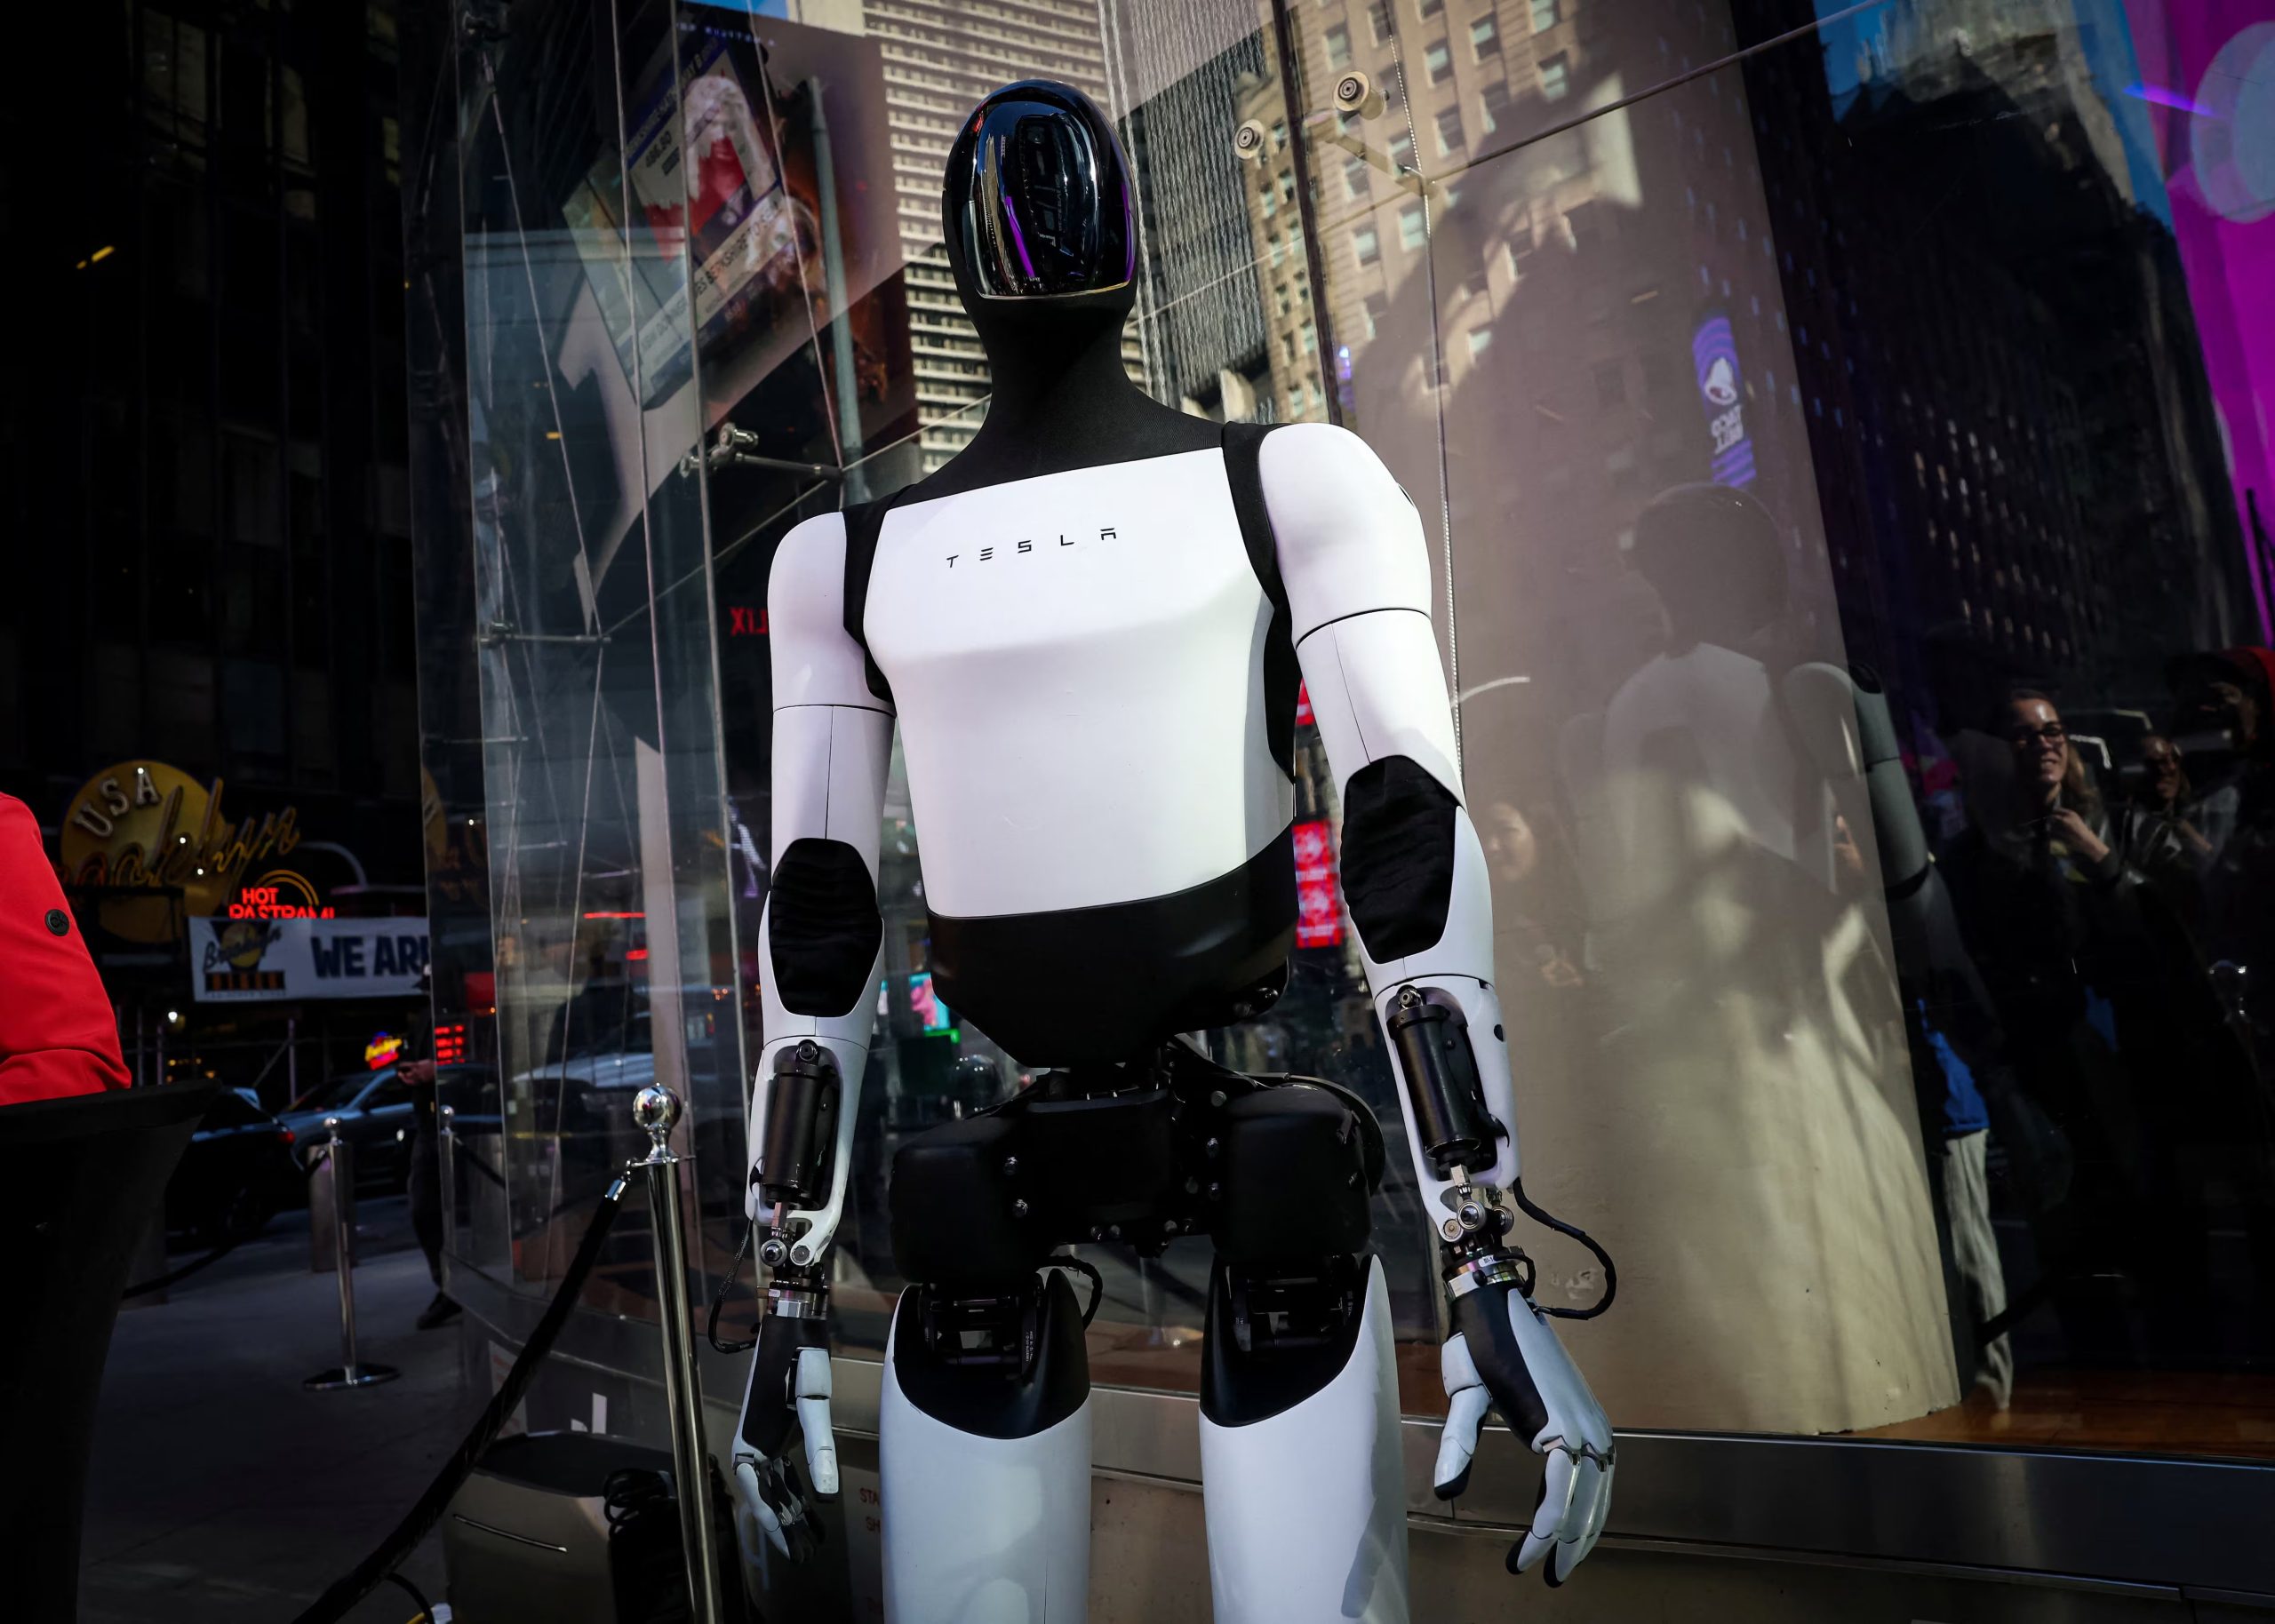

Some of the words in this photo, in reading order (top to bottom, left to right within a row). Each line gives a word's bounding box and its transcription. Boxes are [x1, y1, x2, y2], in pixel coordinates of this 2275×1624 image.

[946, 528, 1116, 568] TESLA
[71, 768, 162, 838] USA
[242, 887, 280, 904] HOT
[310, 935, 365, 977] WE
